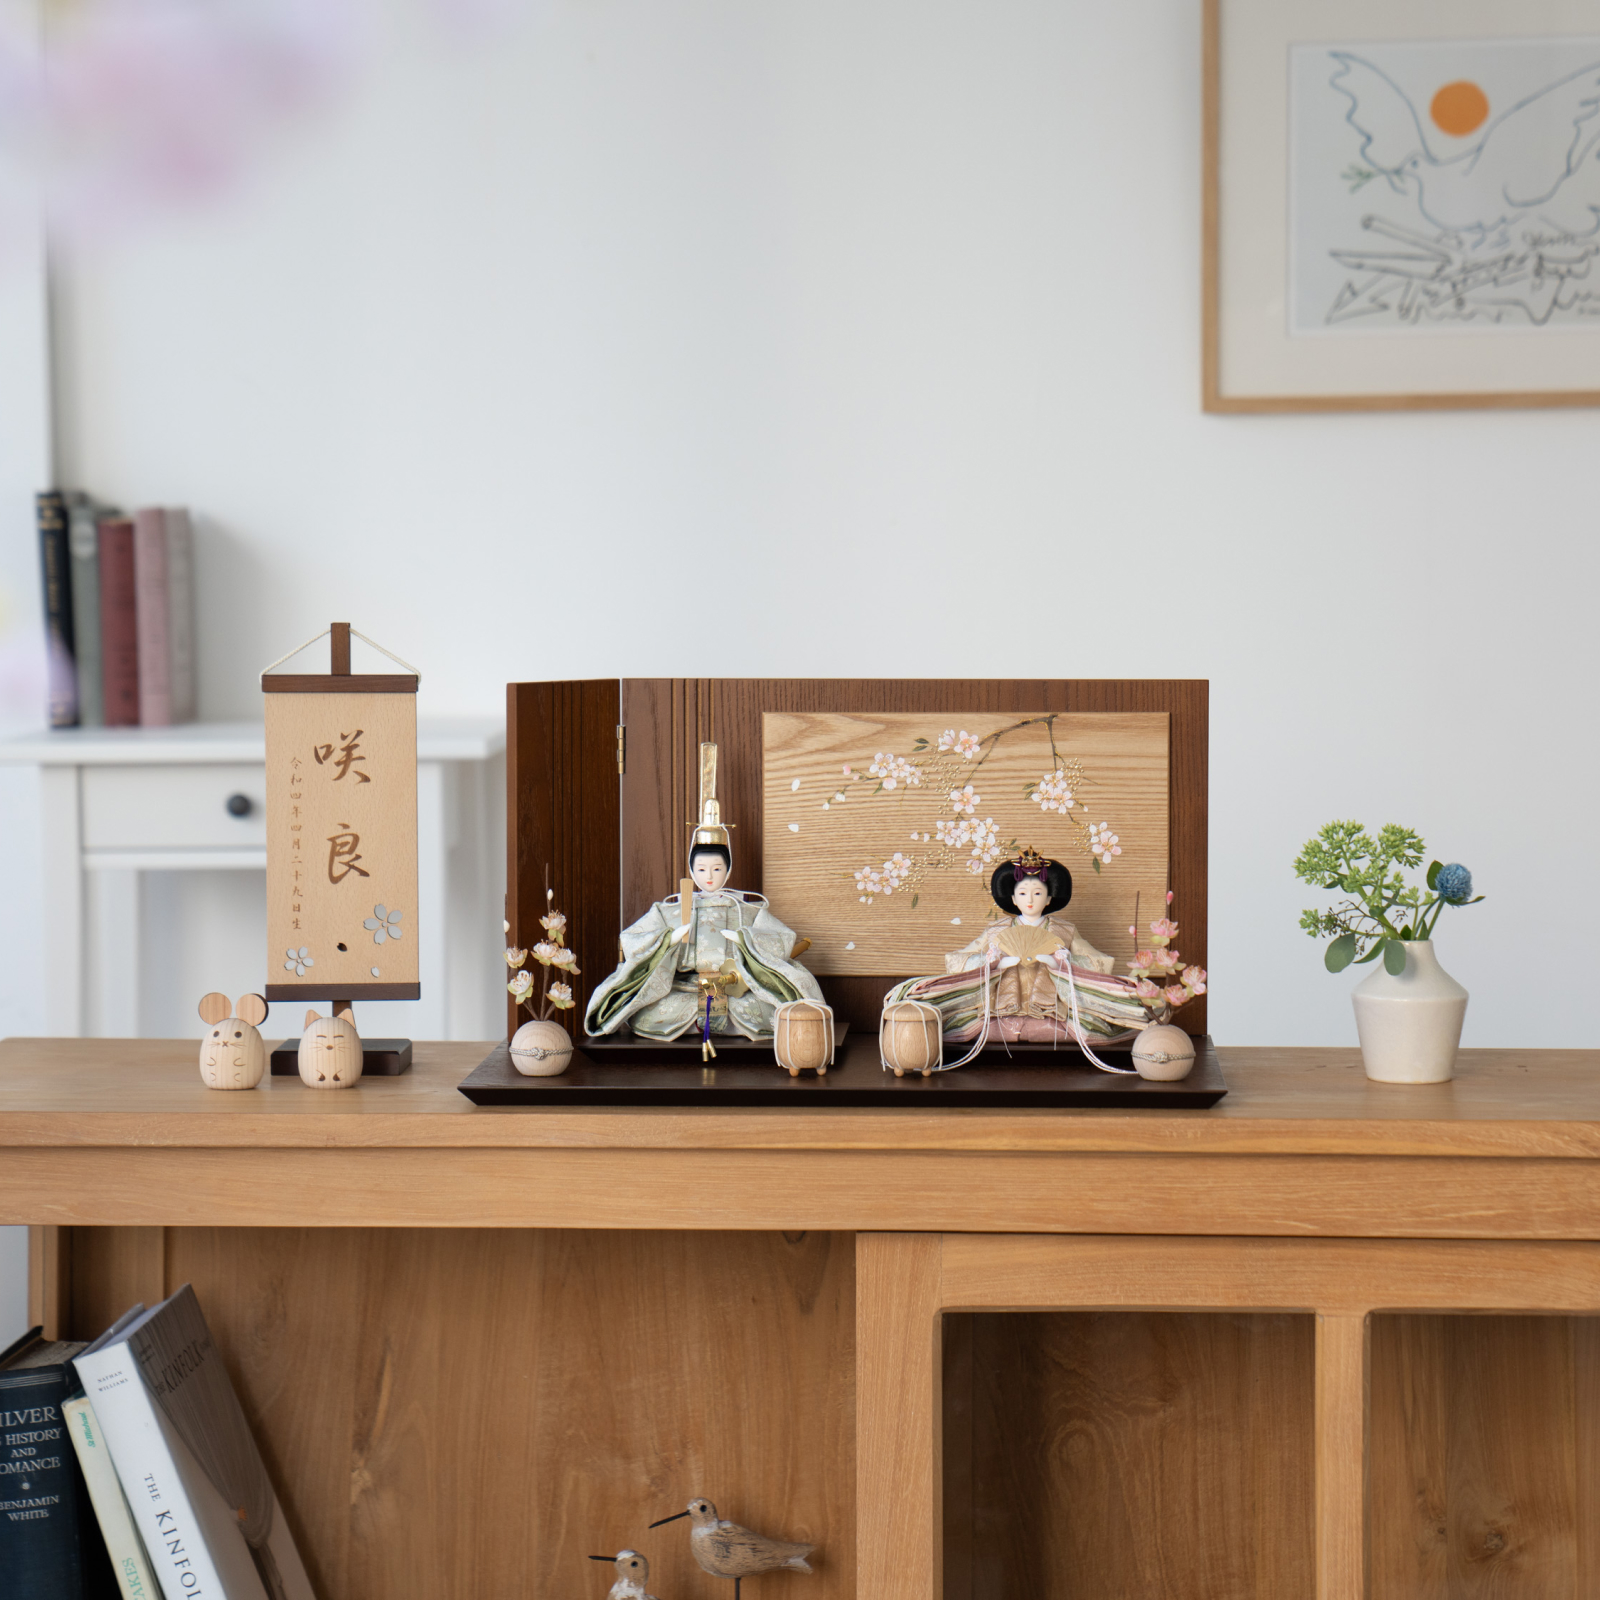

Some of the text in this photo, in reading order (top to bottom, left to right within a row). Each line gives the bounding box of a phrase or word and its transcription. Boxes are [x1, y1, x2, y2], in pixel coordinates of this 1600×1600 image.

[313, 729, 371, 885] 咲良
[290, 756, 303, 930] 令和四年四月二十九日生
[97, 1370, 123, 1383] NATHAN
[98, 1378, 129, 1392] WILLIAMS
[5, 1428, 62, 1446] HISTORY
[11, 1447, 37, 1458] AND
[0, 1456, 61, 1475] OMANCE
[144, 1473, 161, 1502] THE
[7, 1509, 50, 1521] WHITE
[121, 1557, 147, 1600] AKES
